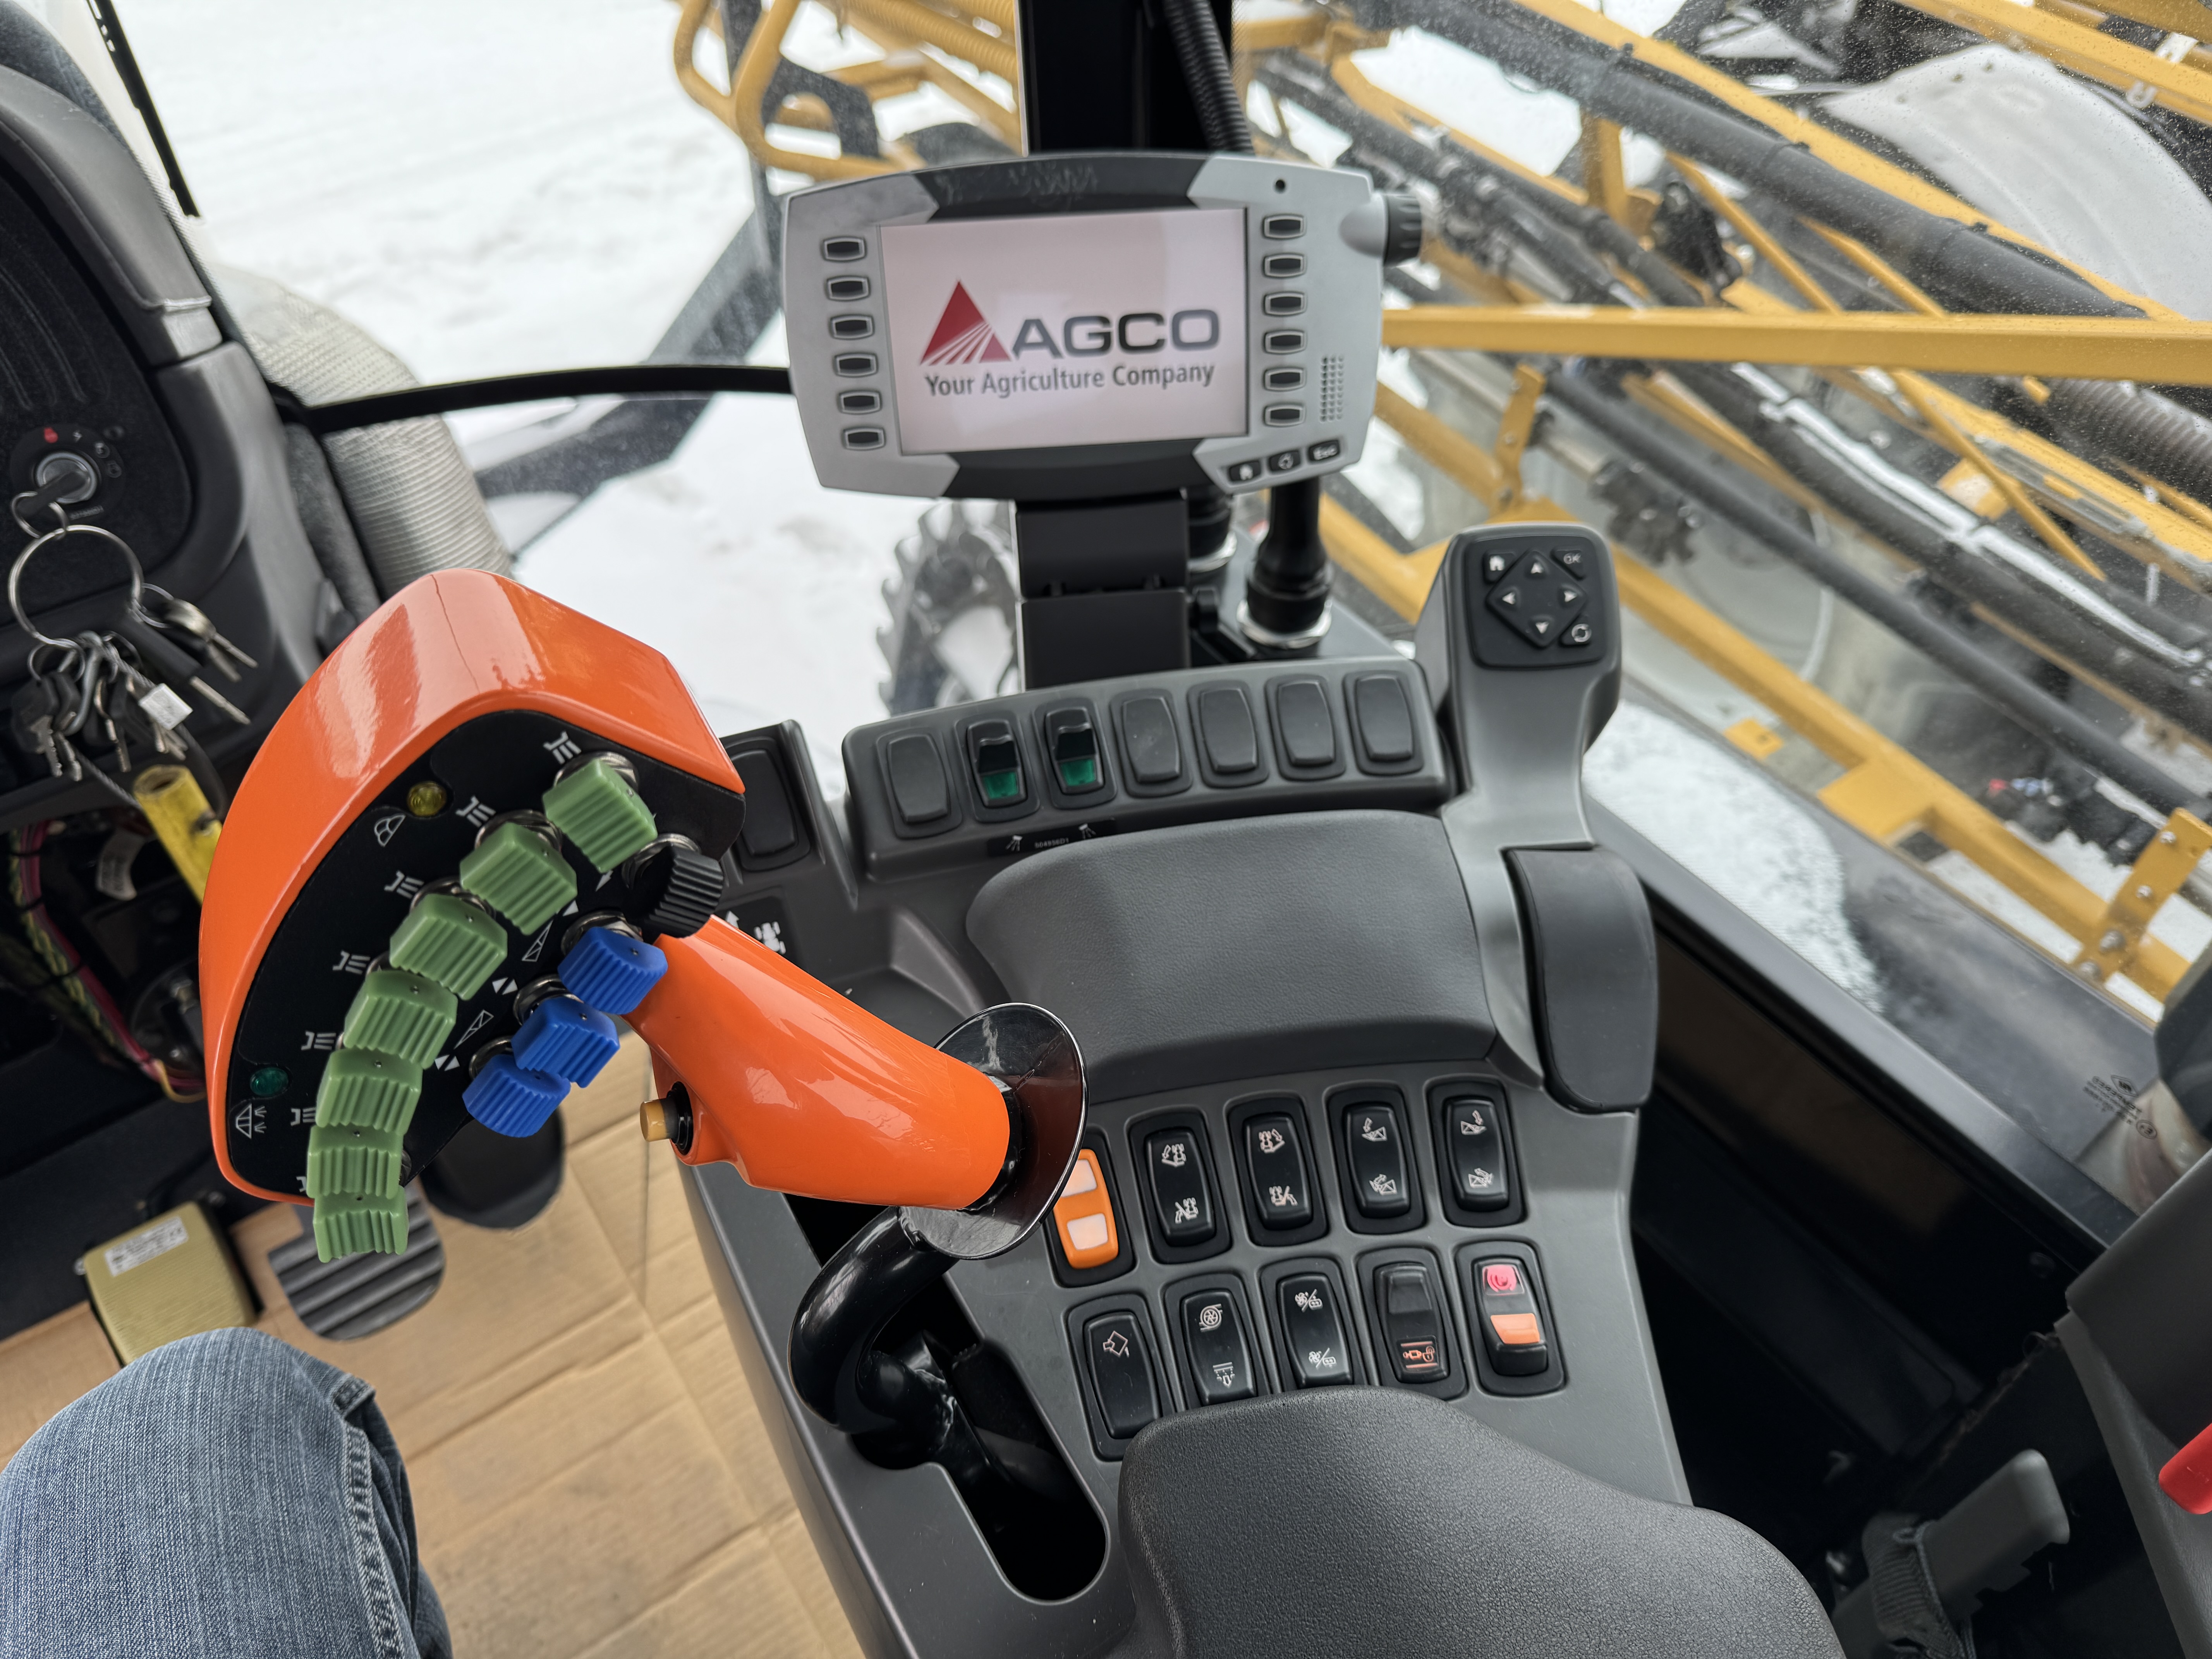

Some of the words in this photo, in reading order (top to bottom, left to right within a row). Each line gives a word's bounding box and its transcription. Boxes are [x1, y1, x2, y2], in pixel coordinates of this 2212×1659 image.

[1012, 309, 1220, 359] AGCO
[924, 374, 974, 396] Your
[981, 366, 1104, 398] Agriculture
[1113, 364, 1214, 390] Company
[1563, 553, 1581, 564] OK
